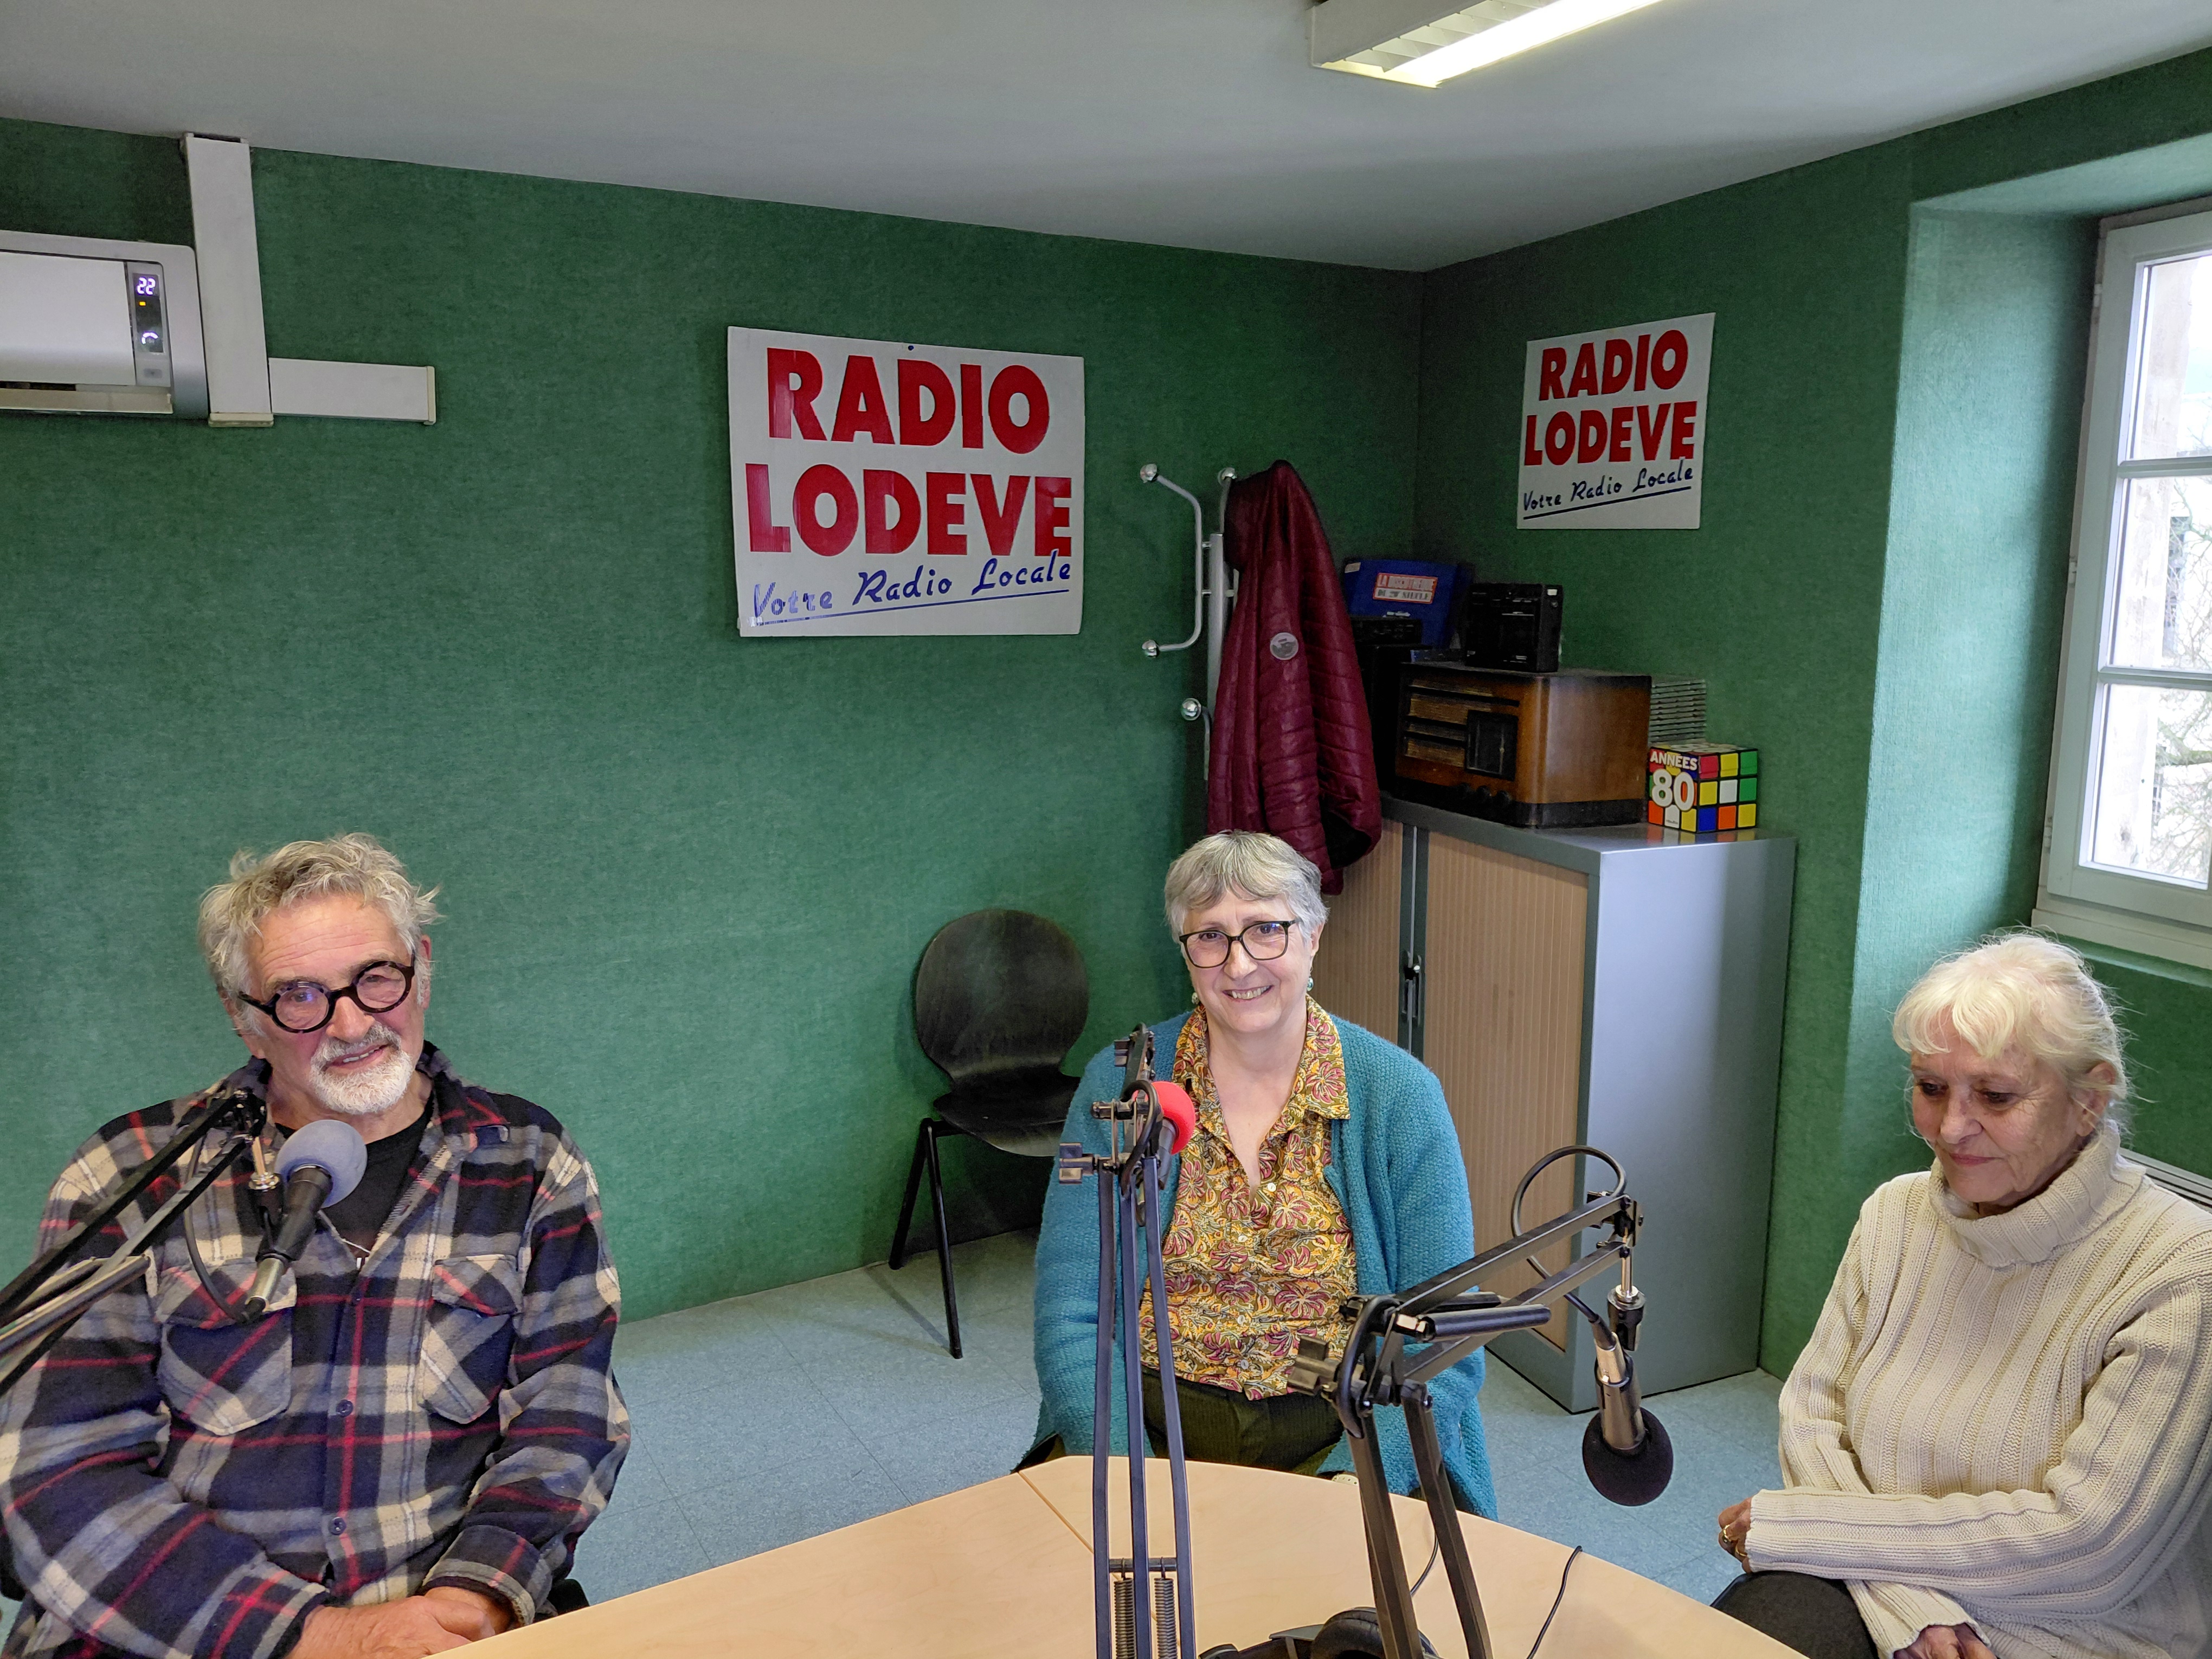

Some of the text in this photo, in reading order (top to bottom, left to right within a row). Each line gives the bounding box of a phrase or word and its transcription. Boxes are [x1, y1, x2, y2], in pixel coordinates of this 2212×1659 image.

[137, 276, 156, 295] 22
[1539, 330, 1688, 401] RADIO
[767, 348, 1050, 454] RADIO
[1524, 401, 1697, 466] LODEVE
[745, 463, 1072, 557] LODEVE
[1523, 458, 1693, 510] Votre Radio Locale
[753, 549, 1071, 620] Votre Radio Locale
[1650, 751, 1697, 770] ANNEES
[1652, 769, 1695, 811] 80
